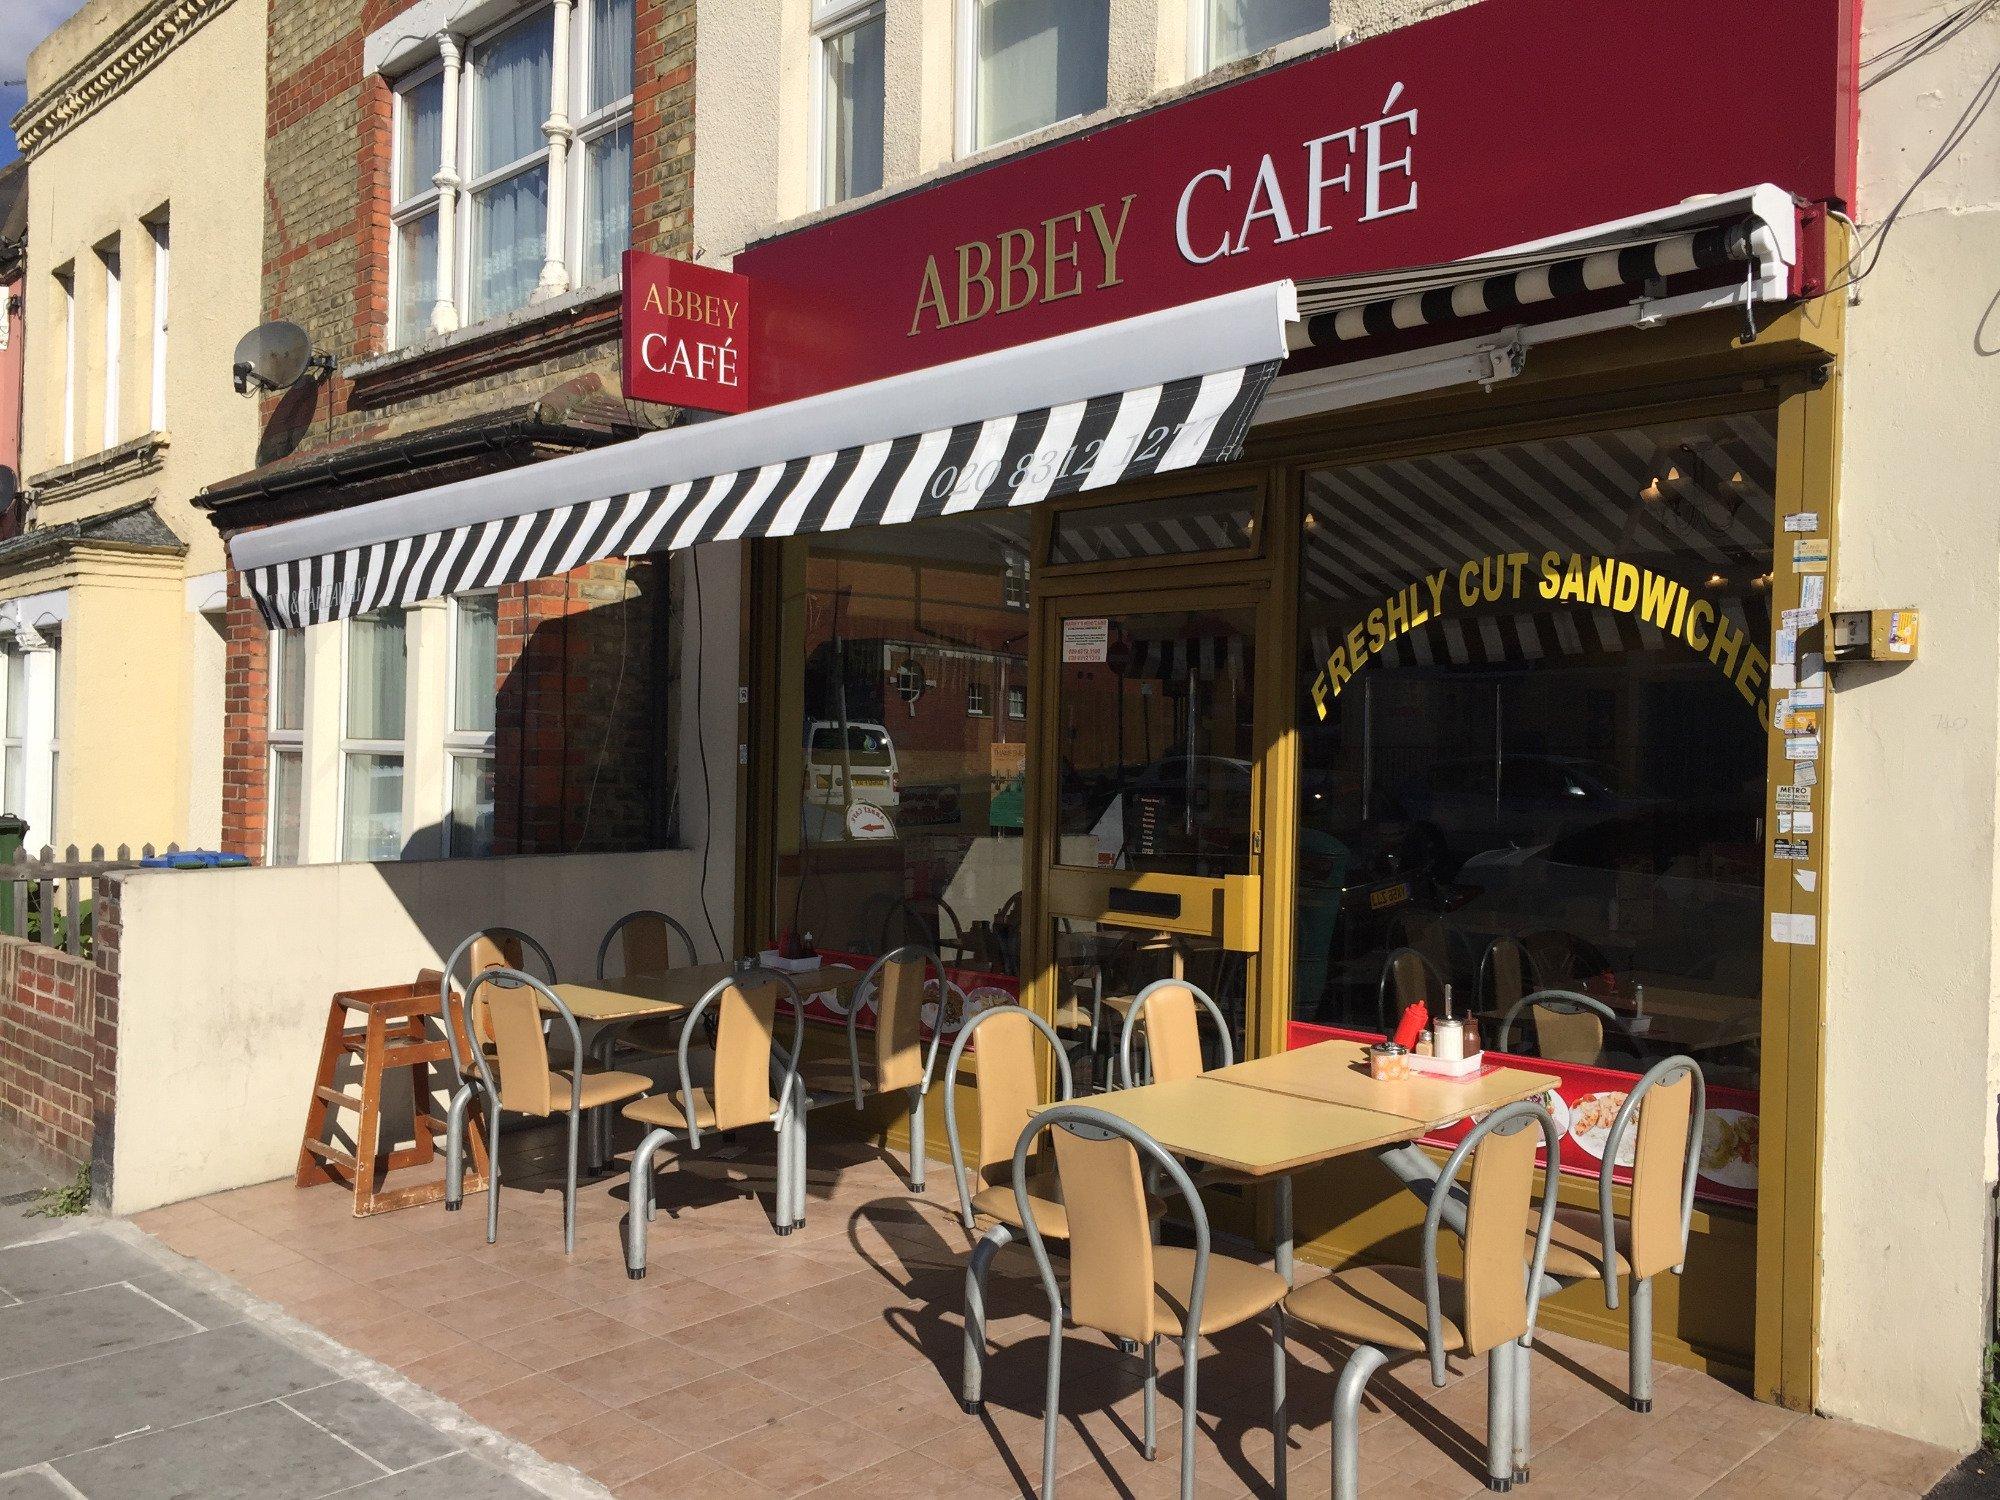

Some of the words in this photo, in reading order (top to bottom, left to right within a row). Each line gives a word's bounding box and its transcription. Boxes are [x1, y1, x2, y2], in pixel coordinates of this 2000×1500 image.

[907, 194, 1138, 337] ABBEY
[1174, 81, 1420, 265] CAFÉ
[643, 283, 739, 330] ABBEY
[641, 333, 739, 387] CAFÉ
[931, 460, 1002, 499] 020
[1008, 439, 1105, 489] 8312
[302, 577, 367, 612] TAKEAWAY
[1310, 568, 1449, 721] FRESHLY
[1459, 552, 1530, 607] CUT
[1780, 786, 1807, 795] METRO
